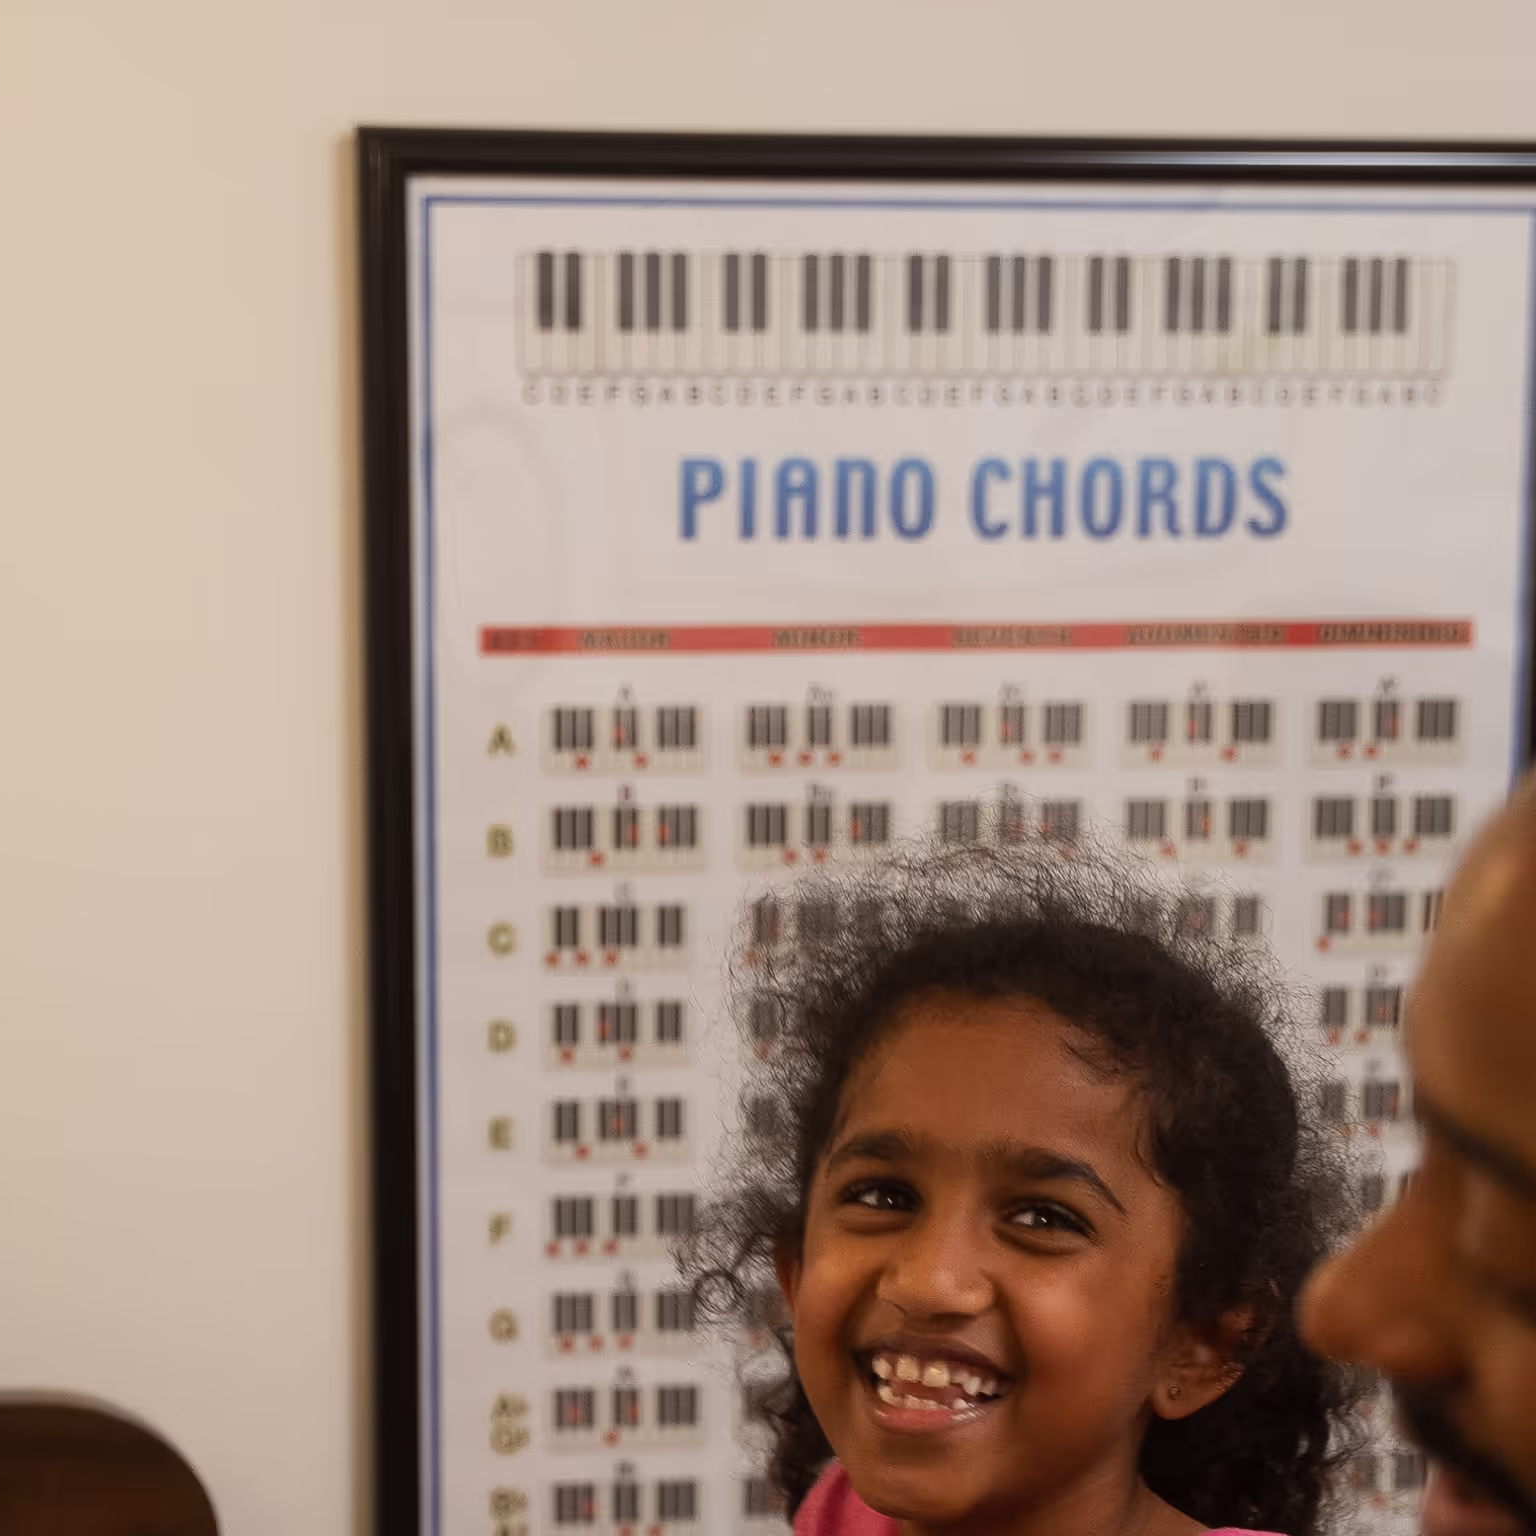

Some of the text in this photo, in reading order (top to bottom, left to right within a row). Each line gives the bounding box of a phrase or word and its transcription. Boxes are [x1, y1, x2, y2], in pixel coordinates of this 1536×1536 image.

[680, 456, 1291, 540] PIANO CHORDS
[487, 721, 516, 757] A
[487, 823, 514, 858] B
